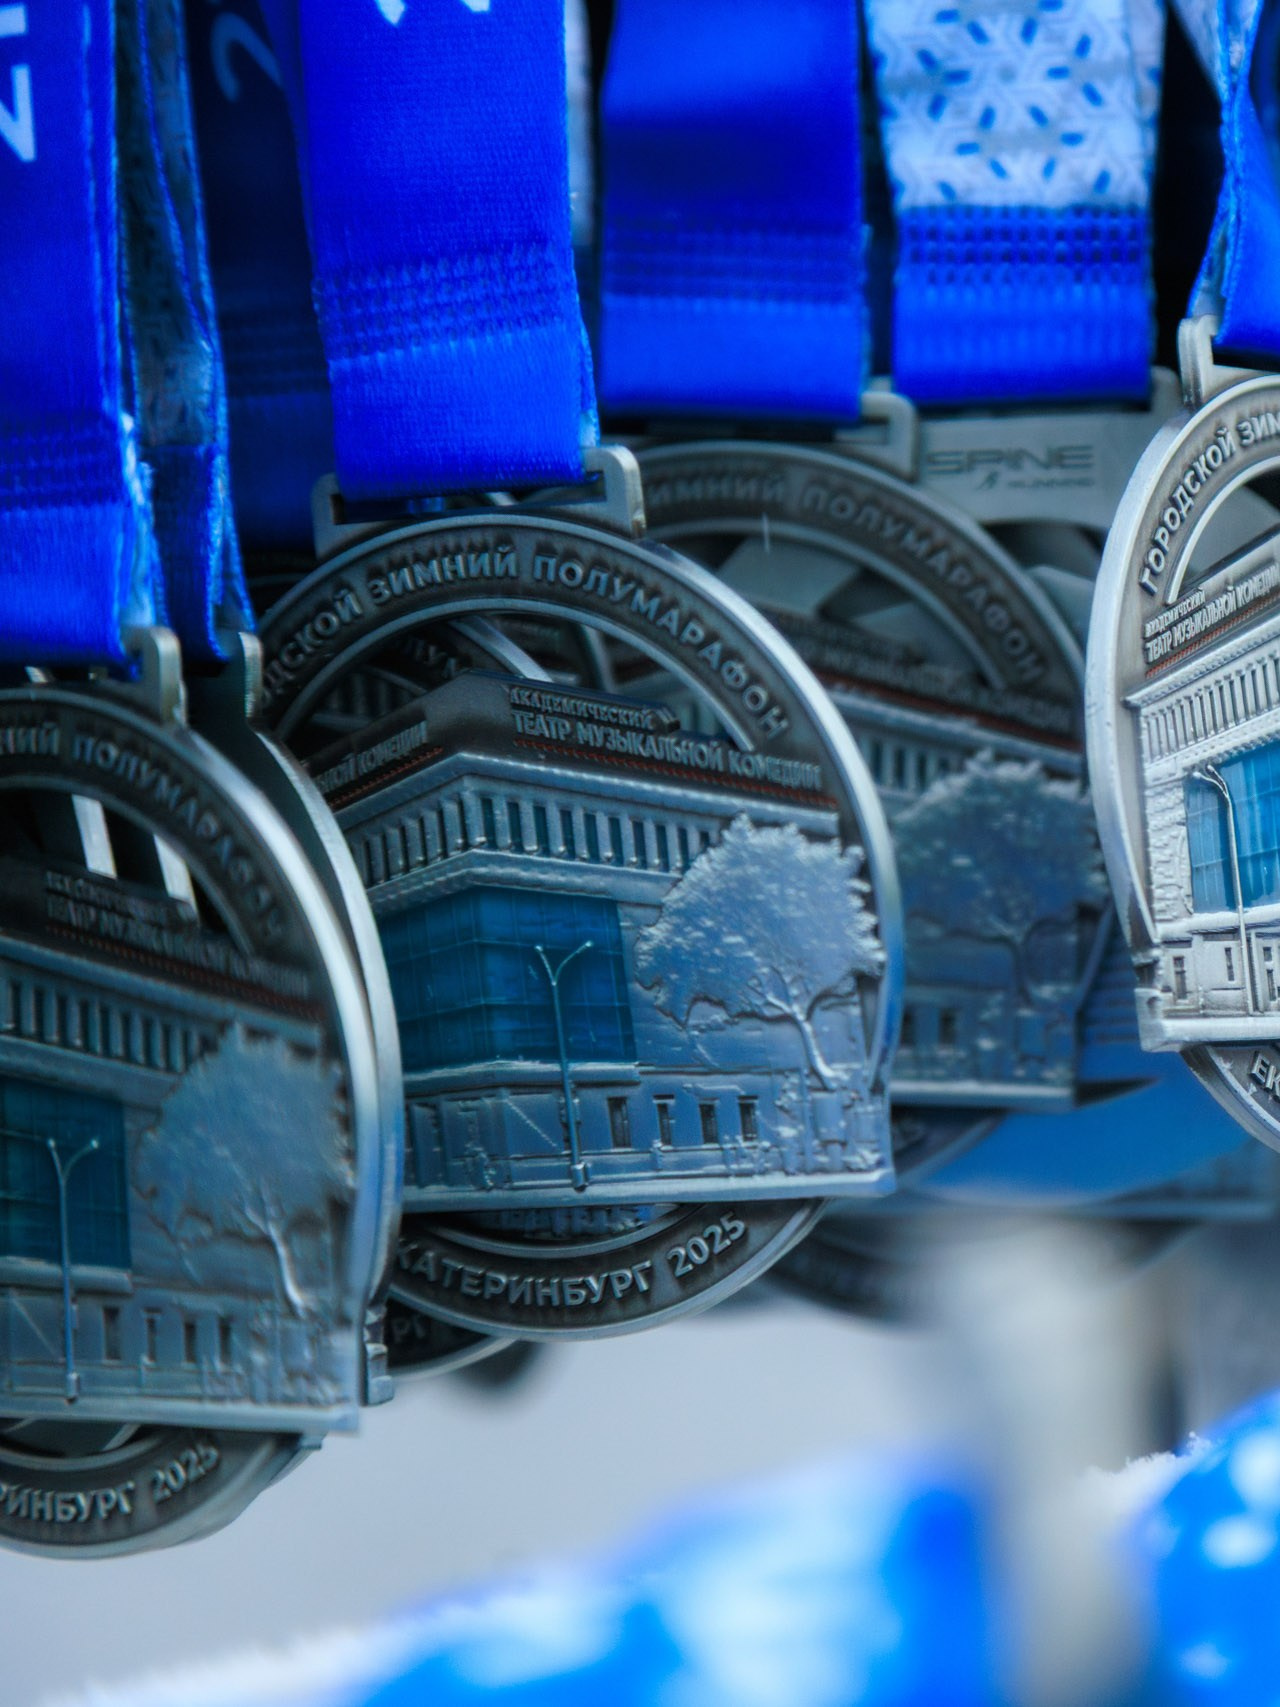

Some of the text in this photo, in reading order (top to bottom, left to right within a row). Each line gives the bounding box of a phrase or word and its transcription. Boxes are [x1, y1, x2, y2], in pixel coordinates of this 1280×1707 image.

[1141, 427, 1236, 596] ГОРОДСКОЙ
[647, 473, 787, 508] ИМНИЙ
[802, 481, 1047, 685] ПОЛУМАРАФОН
[1145, 587, 1206, 638] АКАДЕМИЧЕСКИЙ
[1145, 630, 1173, 663] ТЕАТР
[1173, 585, 1237, 647] МУЗЫКАЛЬНОЙ
[1236, 563, 1280, 608] КОМЕДИИ
[262, 587, 364, 706] ДСКОЙ
[366, 546, 519, 604] ЗИМНИЙ
[533, 553, 790, 741] ПОЛУМАРАФОН
[510, 687, 655, 731] АКАДЕМИЧЕСКИЙ
[511, 712, 823, 791] ТЕАТР МУЗЫКАЛЬНОЙ КОМЕДИИ
[397, 1210, 748, 1307] КАТЕРИНБУРГ 2025
[151, 1442, 219, 1501] 2025
